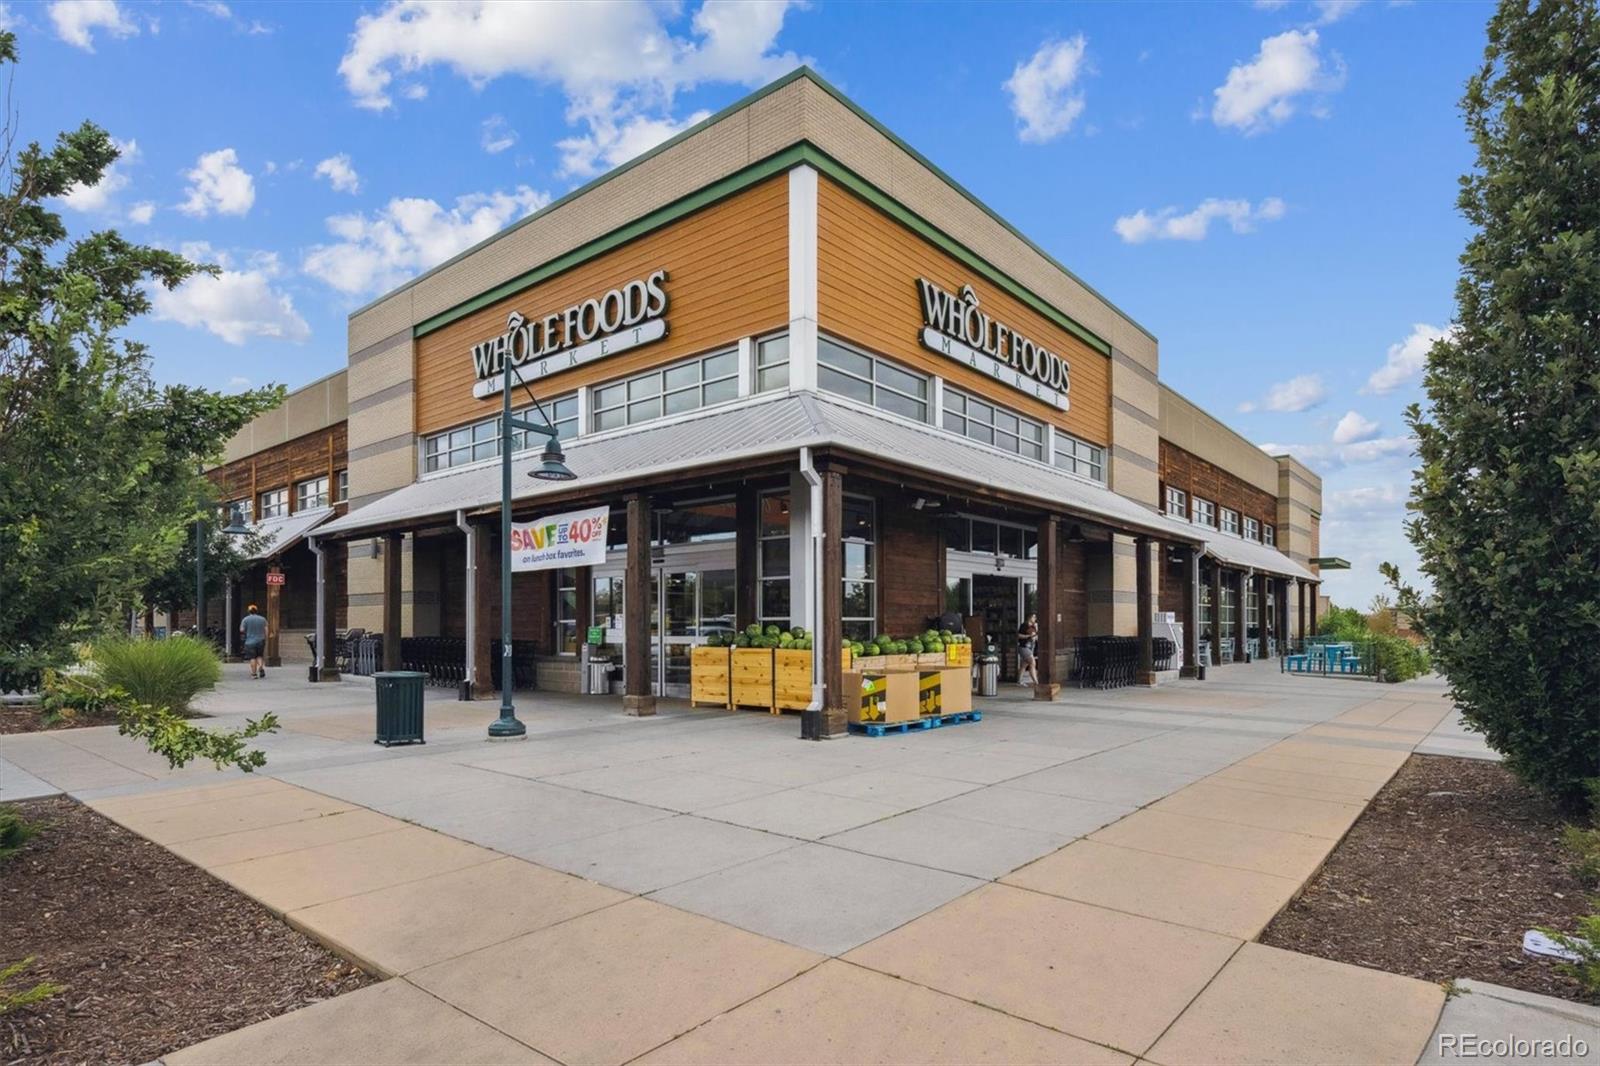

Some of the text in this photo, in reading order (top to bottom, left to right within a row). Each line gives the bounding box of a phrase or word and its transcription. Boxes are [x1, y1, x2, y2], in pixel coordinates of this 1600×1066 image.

[563, 270, 667, 348] FOODS
[941, 336, 1060, 406] MARKET
[1011, 329, 1070, 394] FOODS
[511, 524, 557, 552] SAVE
[592, 530, 602, 538] OFF
